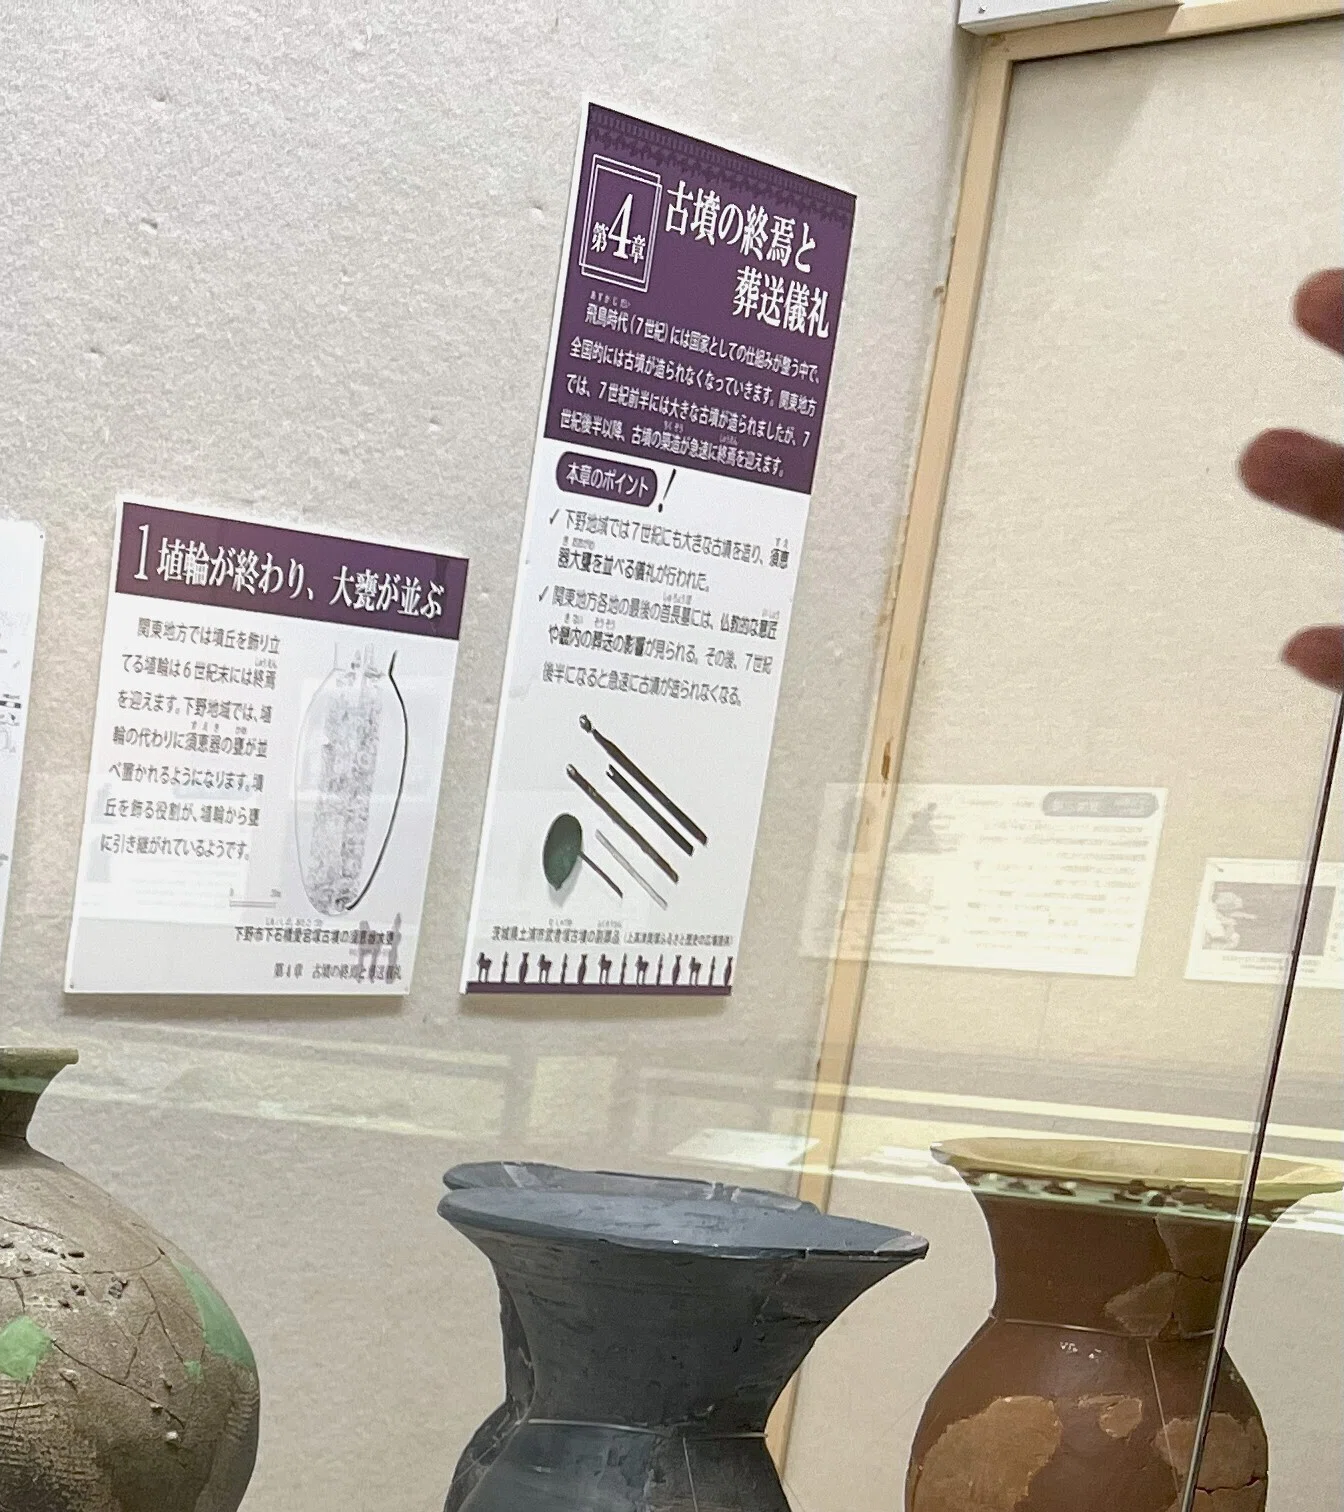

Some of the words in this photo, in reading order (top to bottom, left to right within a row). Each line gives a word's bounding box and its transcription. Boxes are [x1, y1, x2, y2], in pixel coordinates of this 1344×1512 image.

[591, 194, 646, 264] 第4章
[665, 180, 817, 274] 古墳の終焉と
[732, 265, 829, 339] 葬送儀礼
[566, 462, 649, 499] 本章のポイント
[157, 537, 445, 620] 埴輪が終わり、大甕が並ぶ
